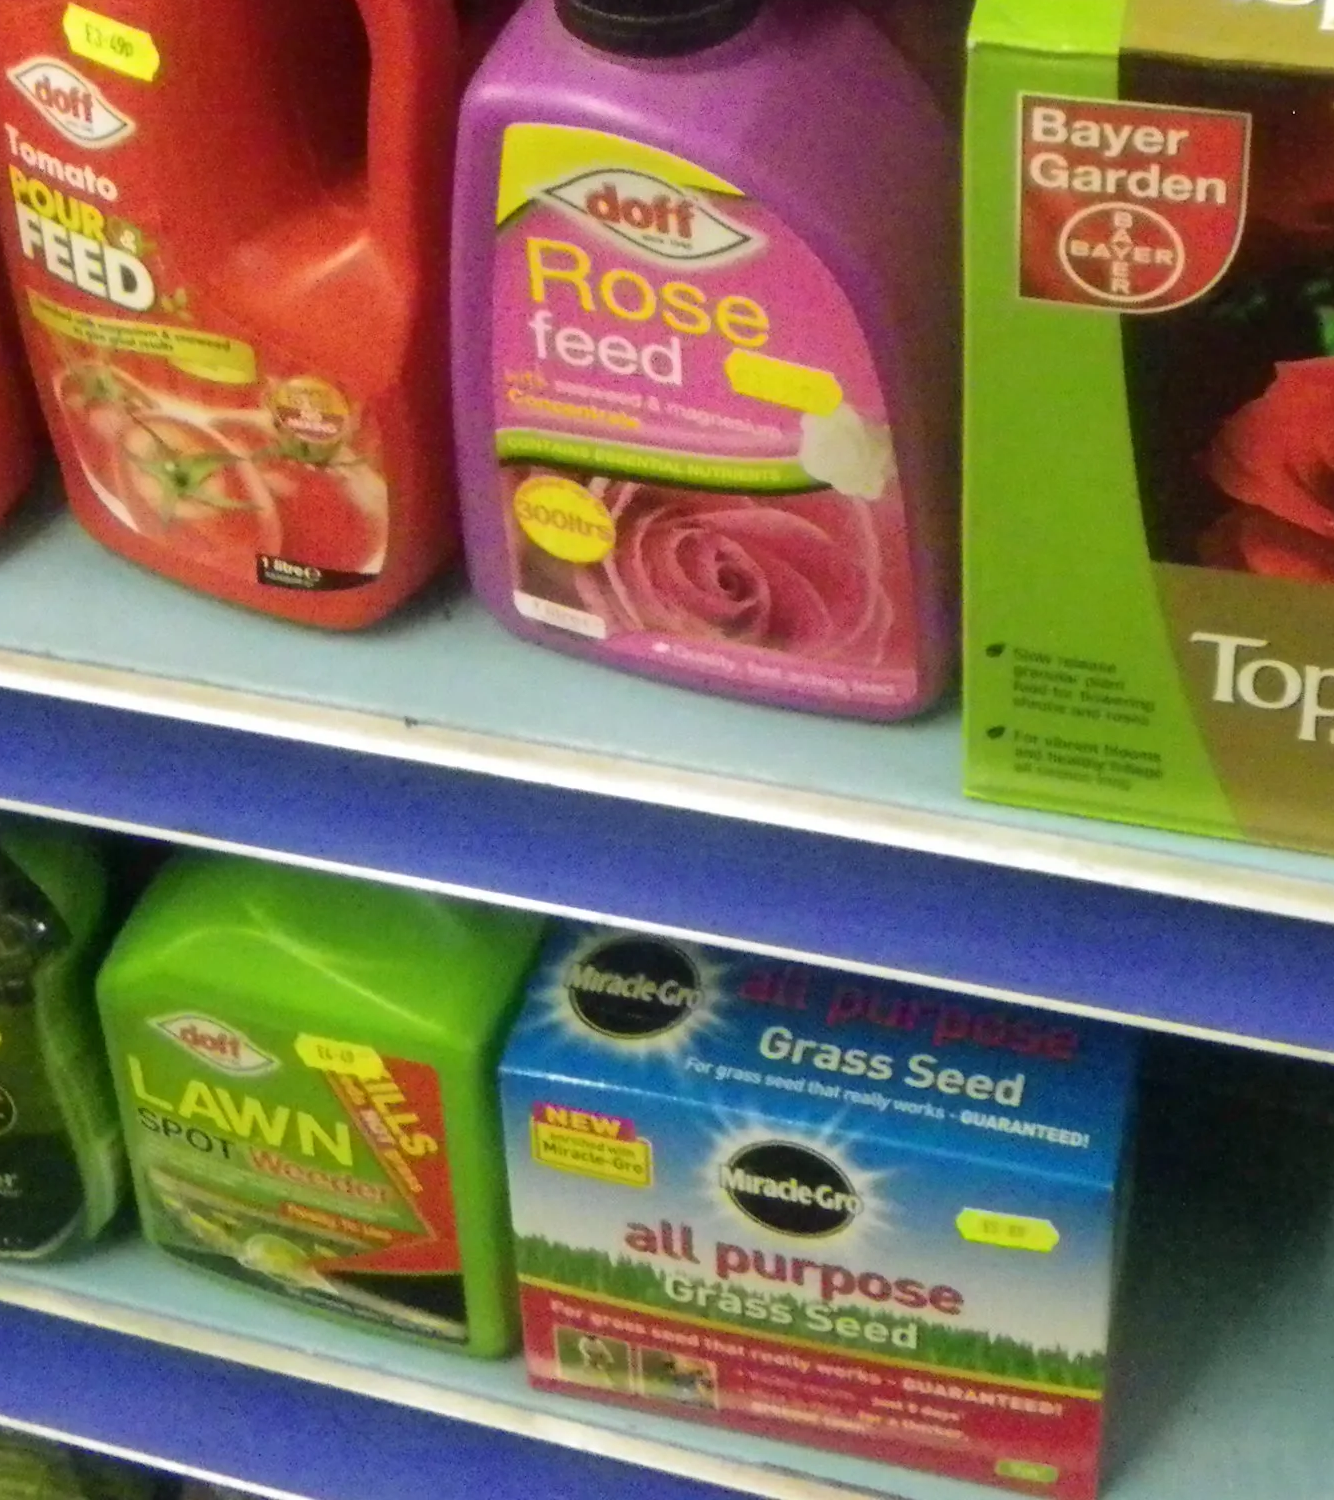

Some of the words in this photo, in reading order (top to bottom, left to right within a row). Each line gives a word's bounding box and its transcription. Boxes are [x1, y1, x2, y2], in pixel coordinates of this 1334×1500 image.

[32, 73, 95, 126] doff
[1028, 106, 1190, 160] Bayer
[4, 123, 119, 202] Tomato
[1028, 152, 1228, 206] Garden
[8, 164, 108, 244] POUR
[119, 228, 137, 254] &
[584, 182, 696, 241] doff
[14, 198, 155, 314] FEED
[1069, 238, 1175, 267] BAYER
[526, 236, 770, 348] Rose
[528, 309, 683, 386] feed
[507, 434, 591, 460] CONTAINS
[566, 960, 703, 1011] Miracle-Gro
[178, 1023, 244, 1060] doff
[758, 1025, 894, 1082] Grass
[903, 1051, 1027, 1108] Seed
[128, 1054, 354, 1168] LAWN
[544, 1104, 621, 1138] NEW
[684, 1056, 713, 1076] For
[715, 1064, 760, 1087] grass
[764, 1069, 804, 1094] seed
[807, 1075, 840, 1099] that
[894, 1096, 945, 1120] works
[959, 1109, 1090, 1150] GUARANTEED!
[136, 1106, 233, 1160] SPOT
[247, 1146, 390, 1204] Weeder
[719, 1165, 865, 1214] Miracle-Gro
[624, 1219, 701, 1265] all
[714, 1240, 965, 1318] purpose
[665, 1273, 792, 1319] Grass
[806, 1304, 920, 1350] Seed
[550, 1299, 585, 1322] For
[592, 1311, 647, 1339] grass
[664, 1325, 699, 1349] seed
[704, 1332, 744, 1357] that
[816, 1362, 882, 1388] works
[901, 1376, 1064, 1417] GUARANTEED!
